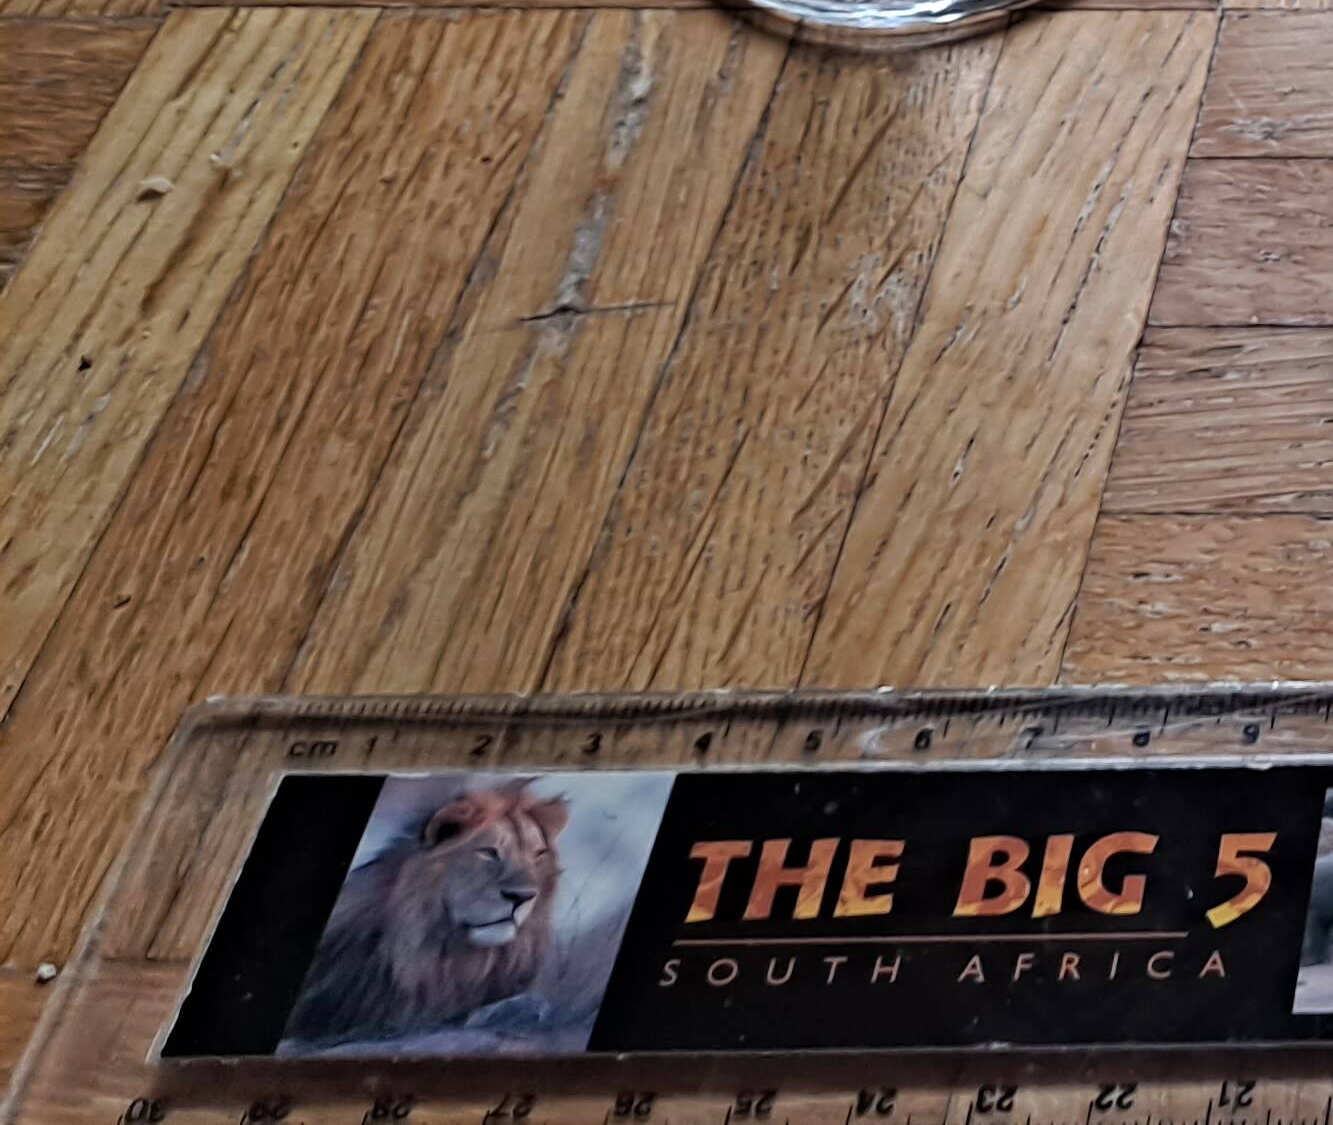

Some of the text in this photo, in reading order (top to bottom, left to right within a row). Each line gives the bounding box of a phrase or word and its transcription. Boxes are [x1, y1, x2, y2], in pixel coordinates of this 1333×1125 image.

[289, 735, 339, 757] cm
[365, 735, 378, 757] 1
[469, 734, 494, 757] 2
[583, 733, 602, 755] 3
[1242, 723, 1260, 744] 9
[685, 832, 1278, 929] THE BIG 5
[659, 951, 1226, 987] SOUTH AFRICA
[488, 1093, 535, 1119] 27
[734, 1089, 777, 1116] 25
[977, 1084, 1018, 1112] 23
[1095, 1083, 1137, 1109] 22
[1218, 1081, 1256, 1107] 21
[125, 1099, 165, 1123] 30
